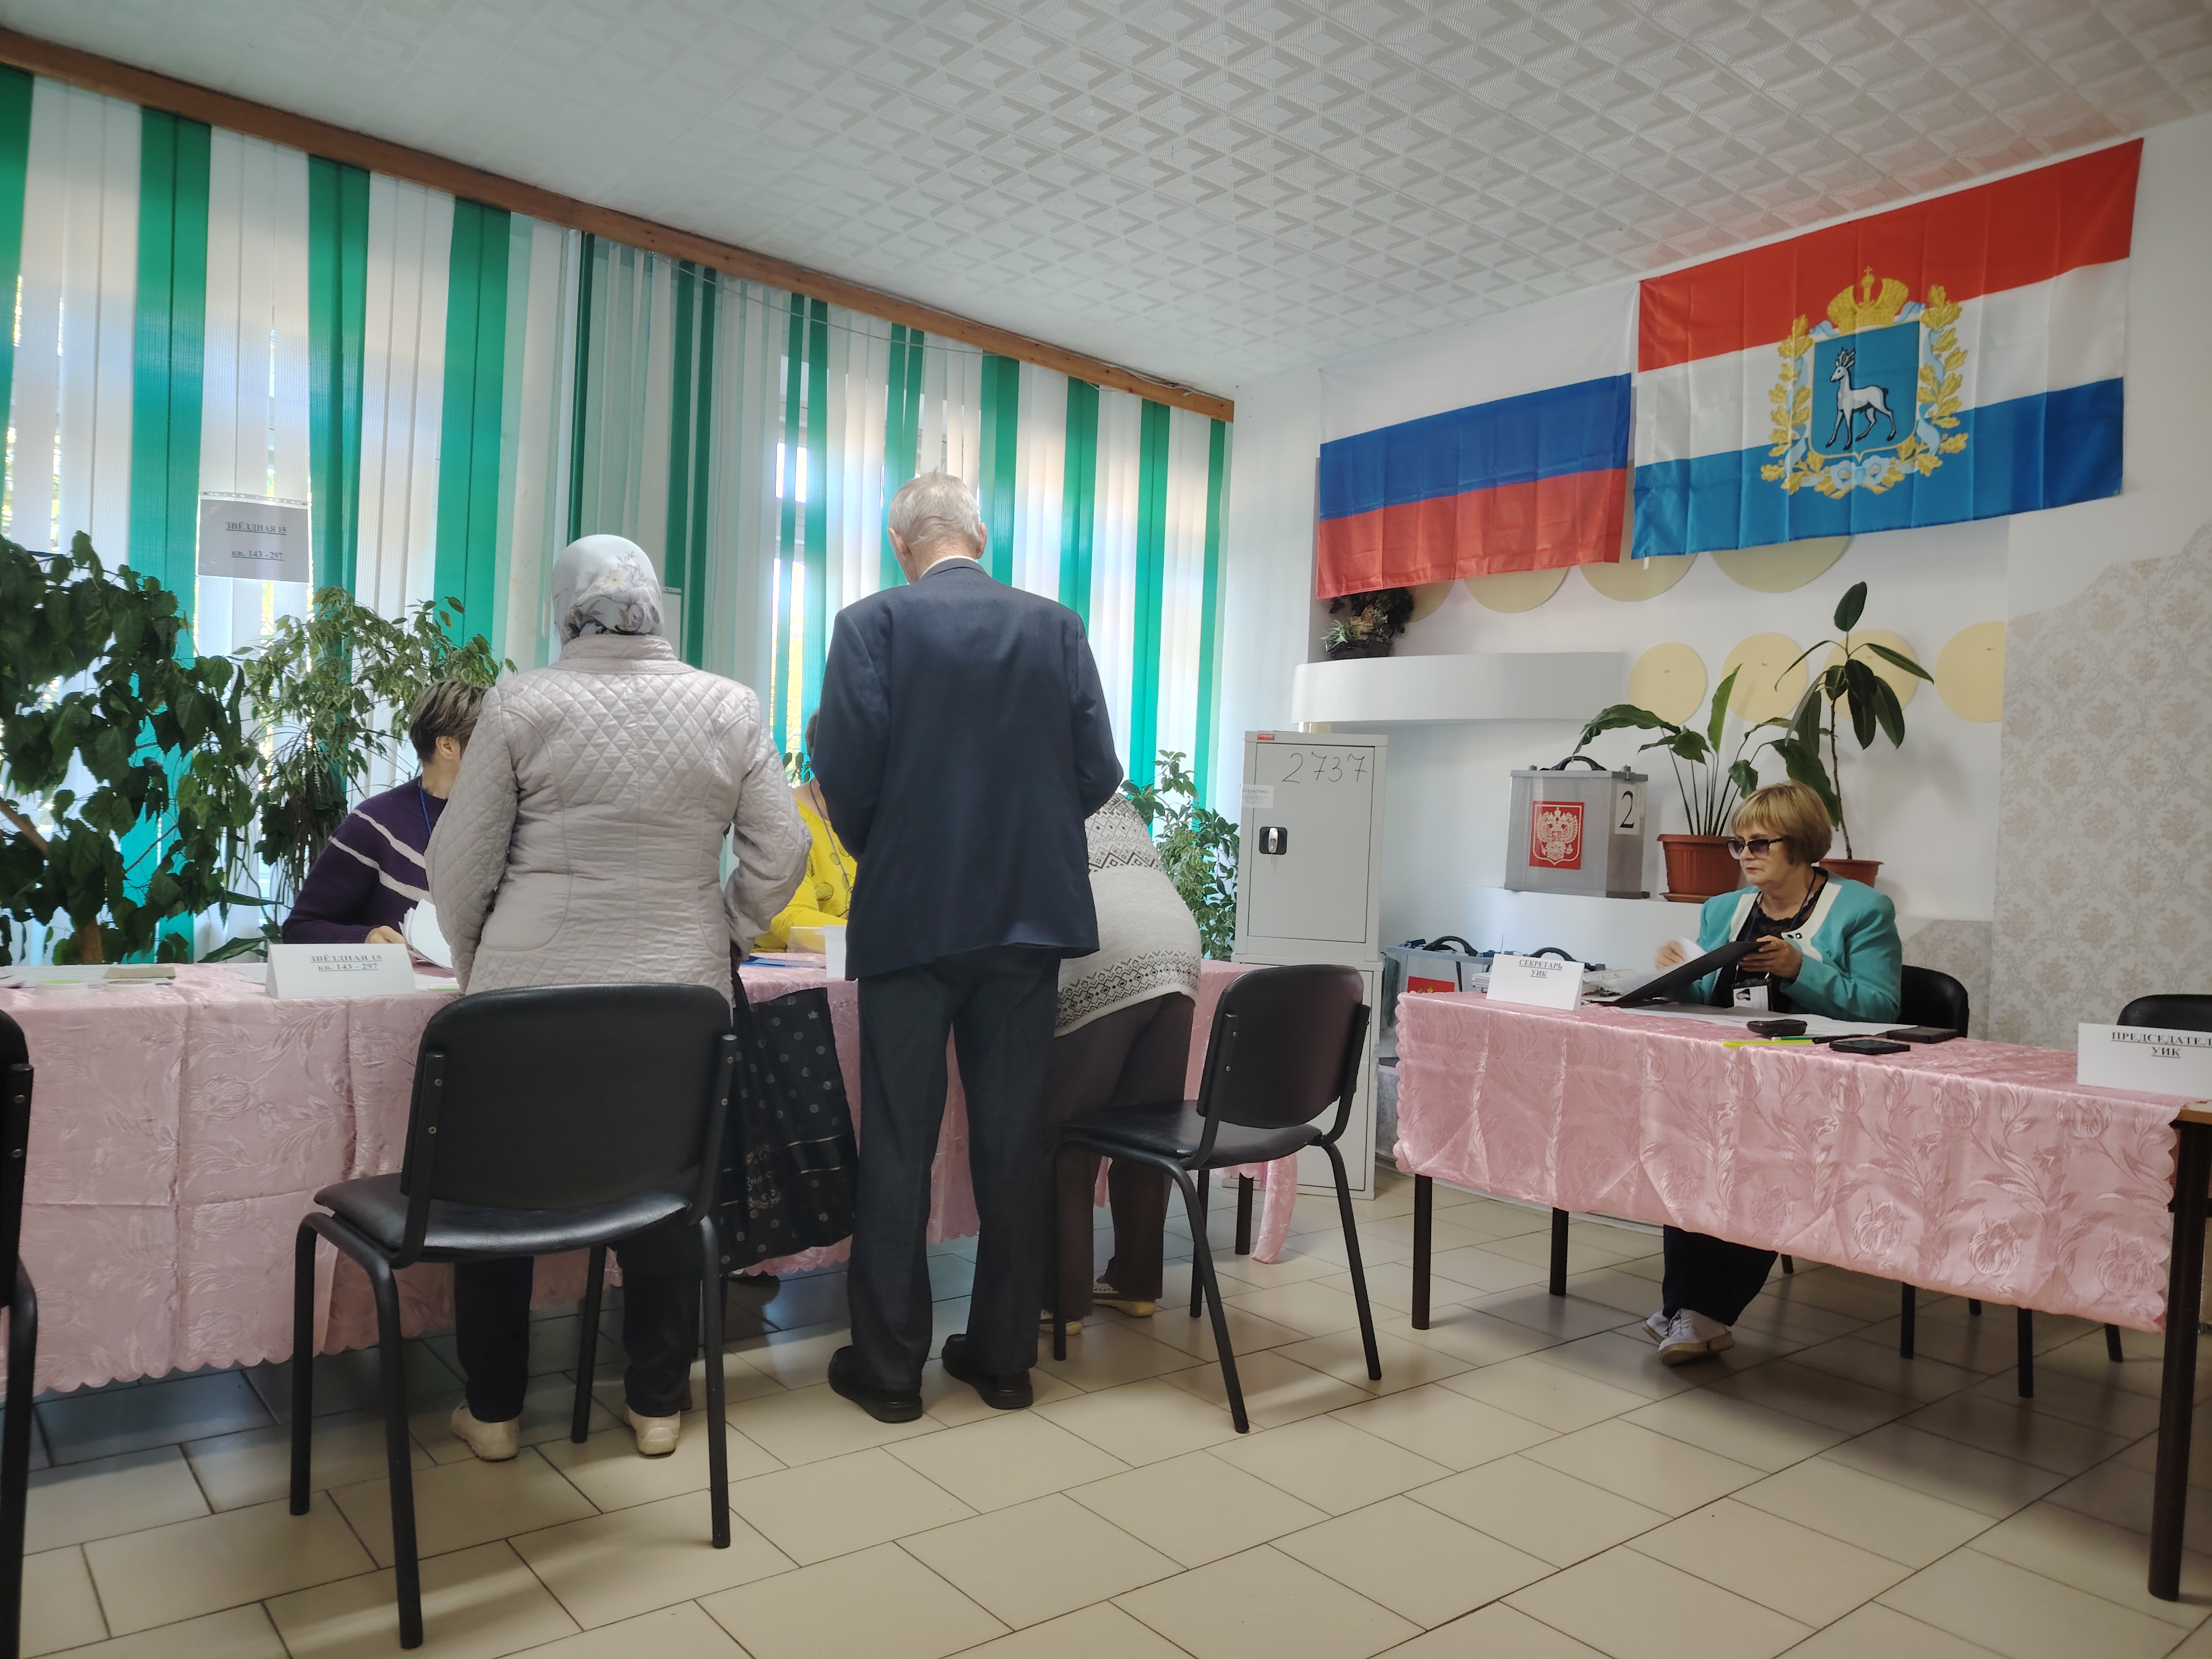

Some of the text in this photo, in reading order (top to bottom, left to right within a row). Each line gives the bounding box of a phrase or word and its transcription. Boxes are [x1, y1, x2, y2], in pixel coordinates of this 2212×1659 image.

[226, 521, 275, 533] ЗВЁЗДНАЯ
[1282, 751, 1368, 784] 2737
[1620, 791, 1635, 828] 2
[1519, 959, 1562, 969] СЕКРЕТАРЬ
[2152, 1047, 2180, 1056] УИК
